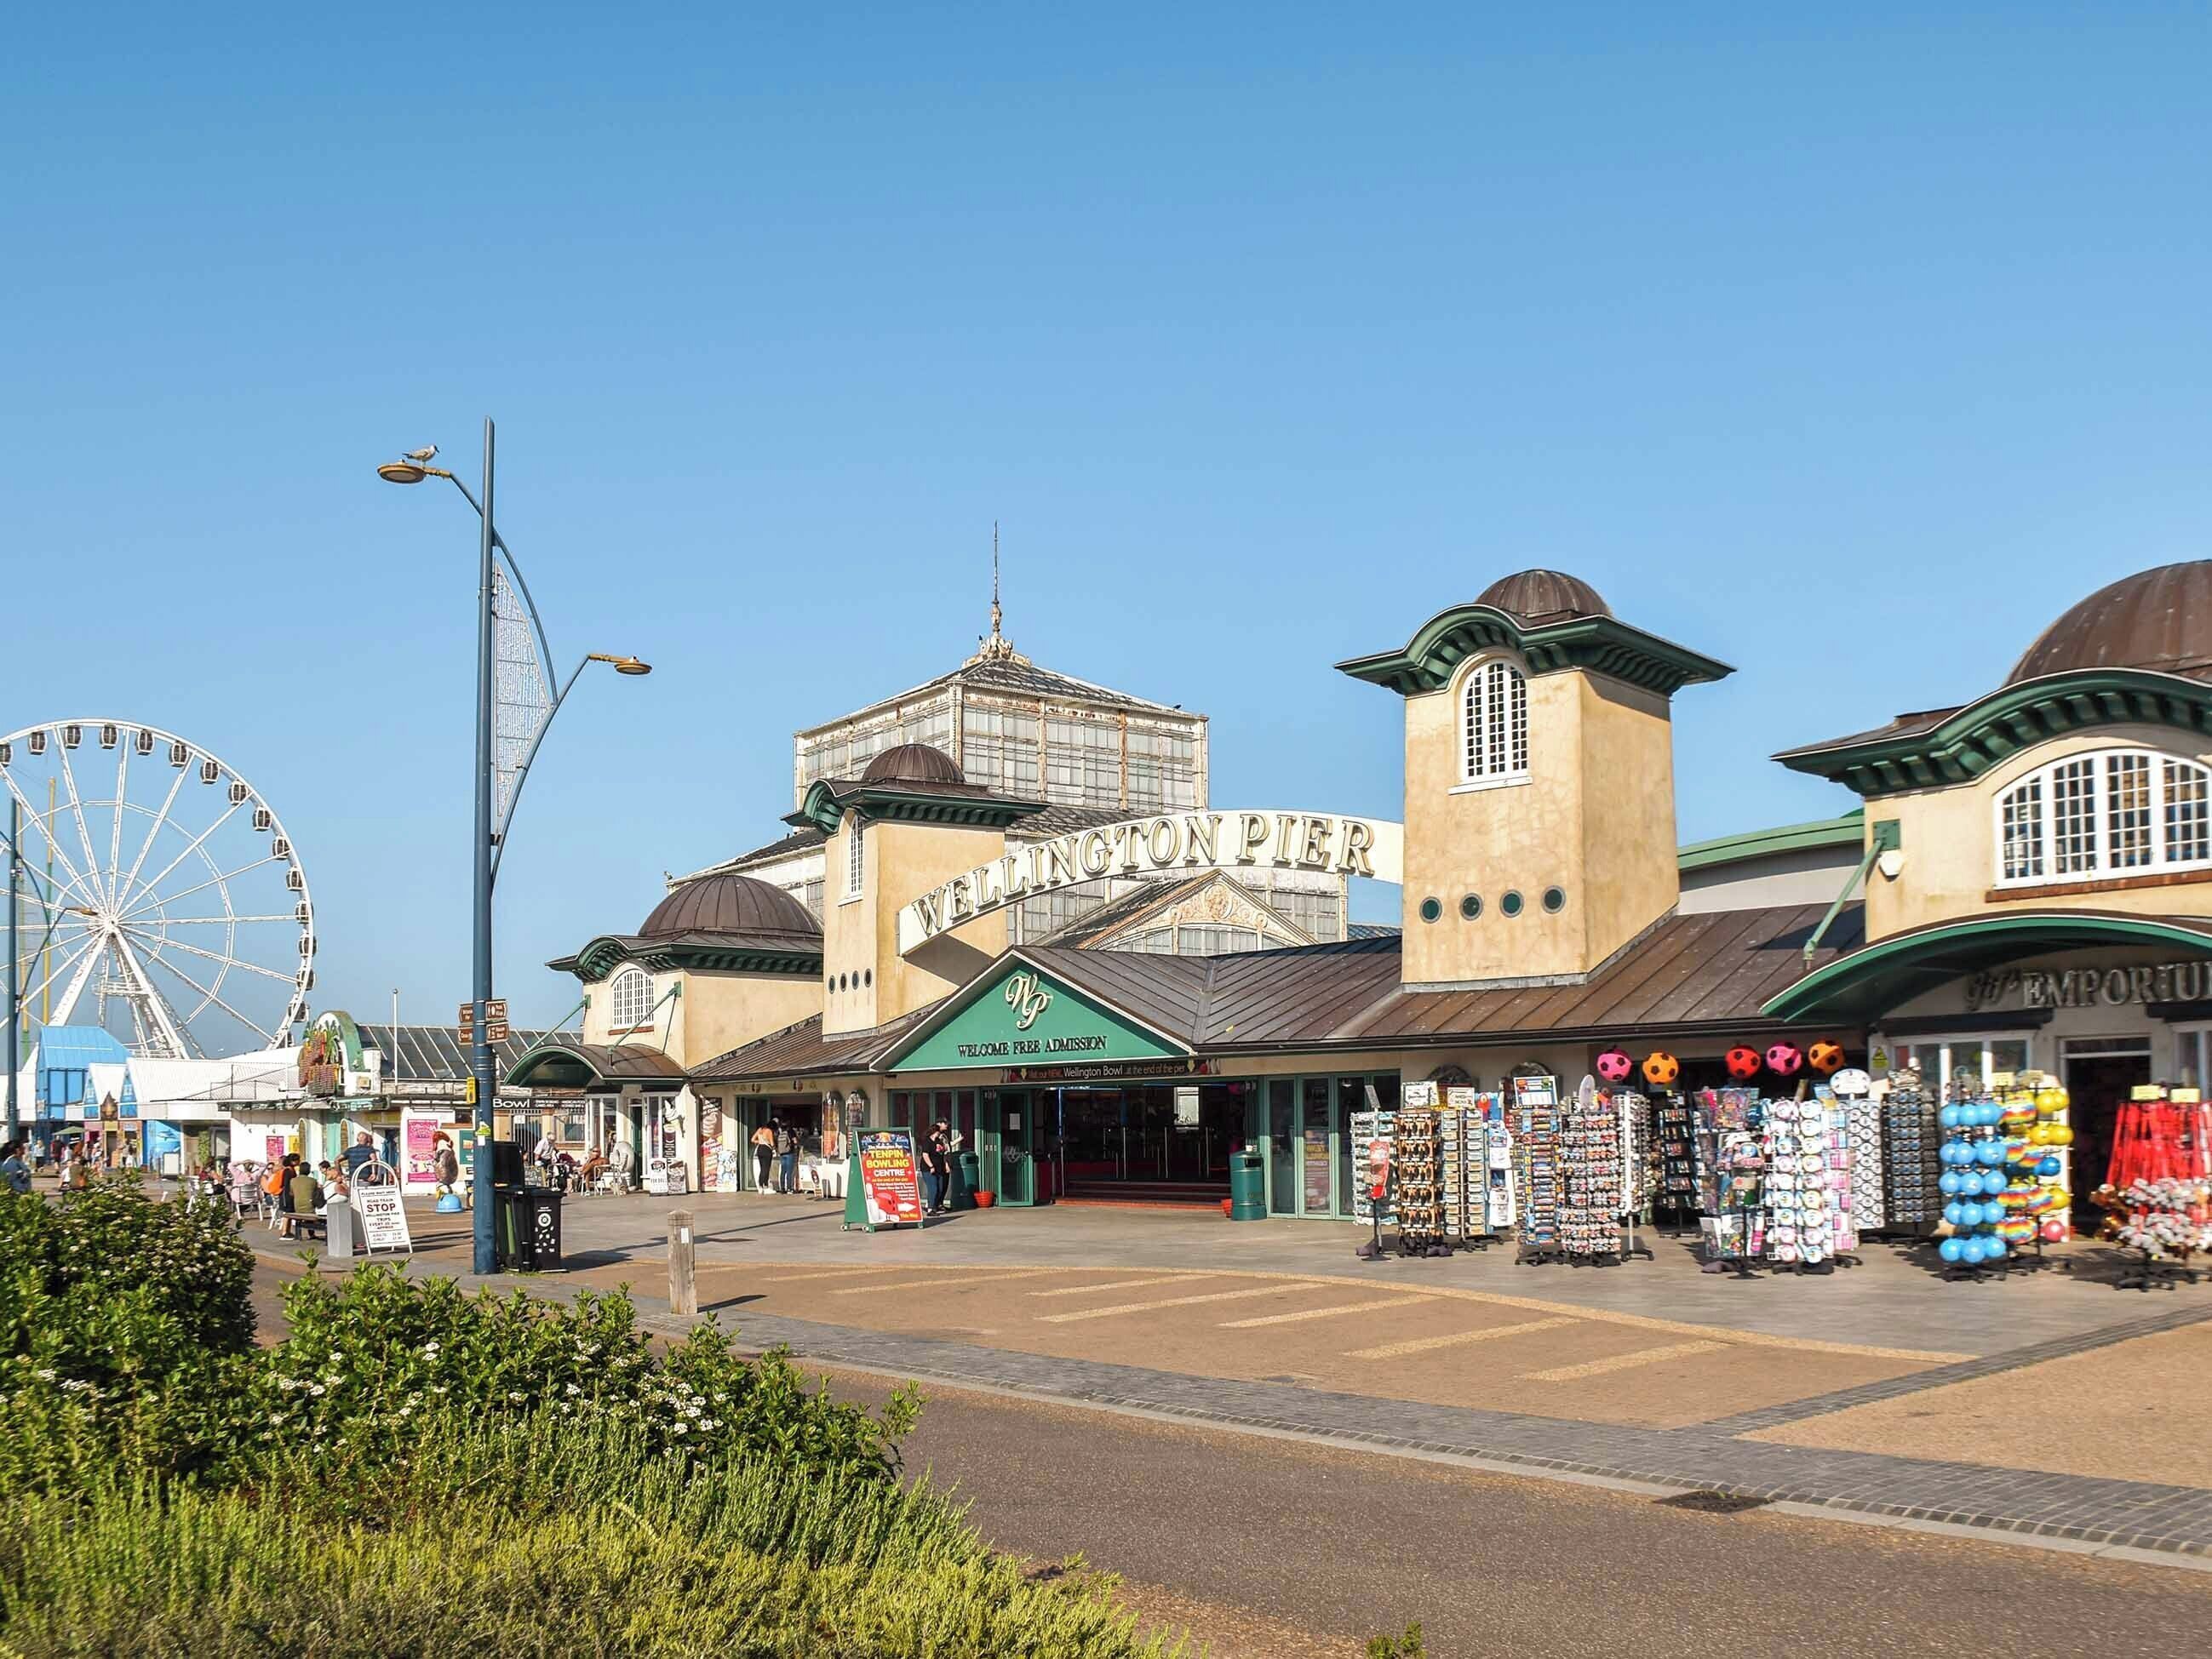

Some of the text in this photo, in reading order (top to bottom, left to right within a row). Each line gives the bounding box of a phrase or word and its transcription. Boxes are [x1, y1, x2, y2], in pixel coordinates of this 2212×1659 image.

[912, 814, 1375, 935] WELLINGTON PIER
[958, 1035, 1107, 1057] WELCOME FREE ADMISSION
[1063, 1067, 1102, 1078] Wellington
[1103, 1066, 1123, 1076] Bowl
[492, 1098, 530, 1108] Bowl
[869, 1149, 904, 1158] TENPIN
[866, 1158, 909, 1169] BOWLING
[873, 1169, 905, 1177] CENTRE
[367, 1203, 395, 1212] STOP
